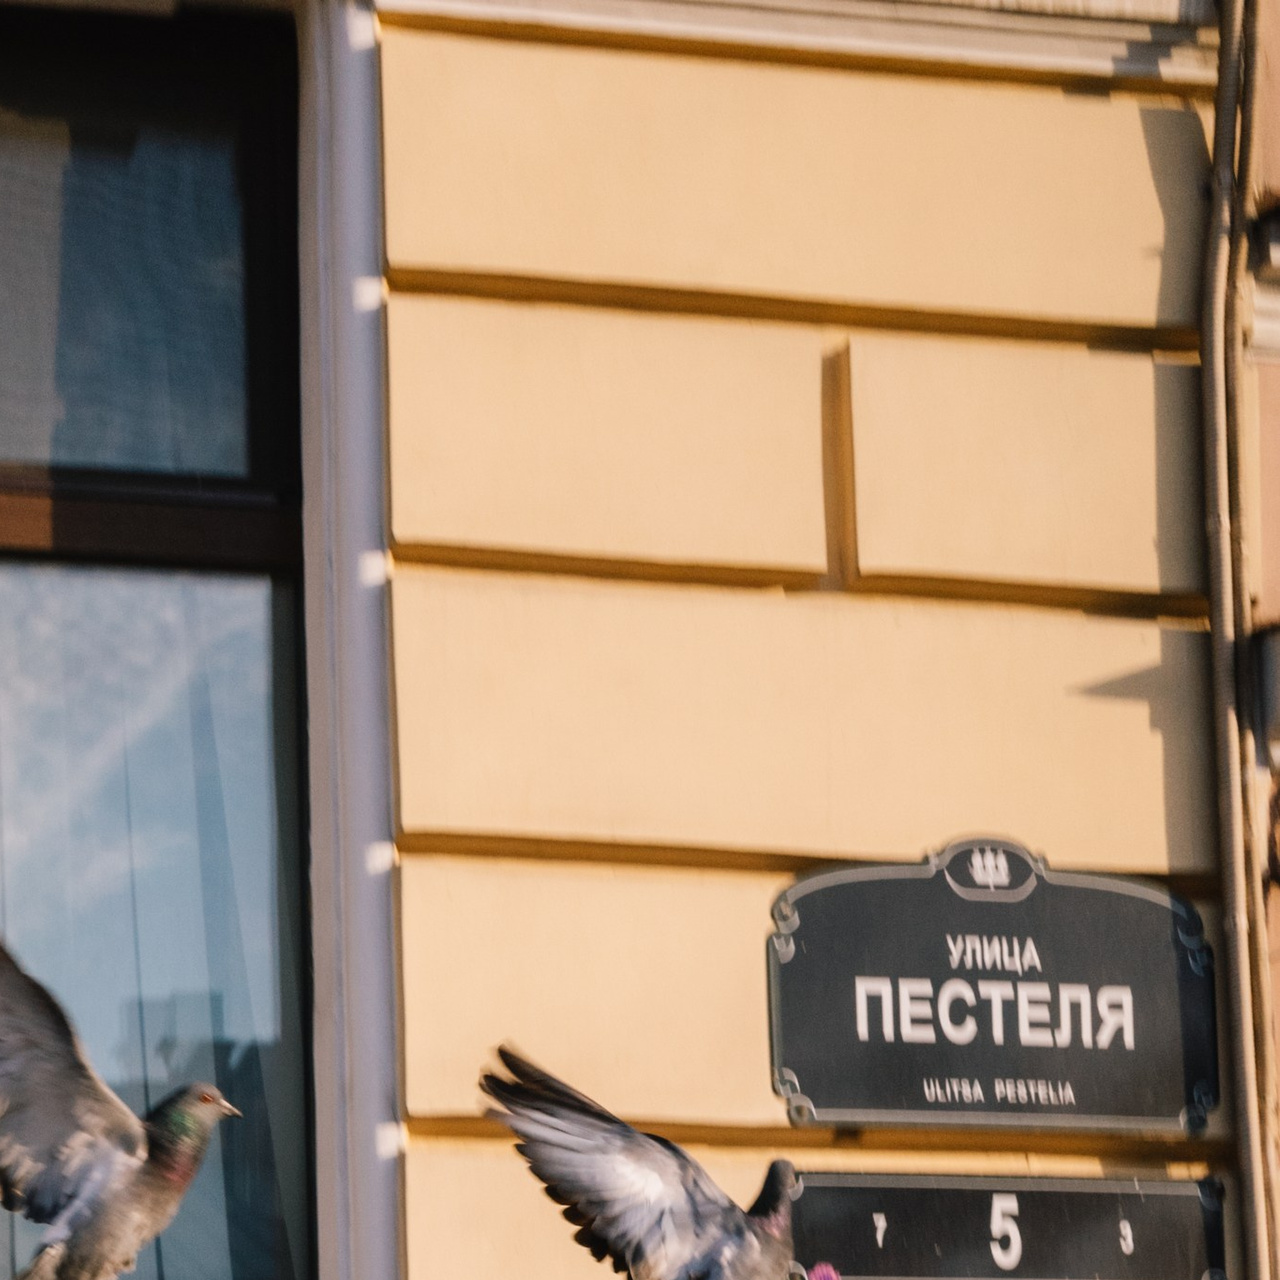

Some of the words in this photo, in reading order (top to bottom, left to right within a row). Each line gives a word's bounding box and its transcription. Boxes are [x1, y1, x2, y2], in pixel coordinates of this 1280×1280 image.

[946, 934, 1042, 975] УЛИЦА
[854, 975, 1135, 1050] ПЕСТЕЛЯ
[923, 1078, 985, 1103] ULITSA
[994, 1078, 1076, 1105] PESTELIA
[989, 1193, 1022, 1271] 5
